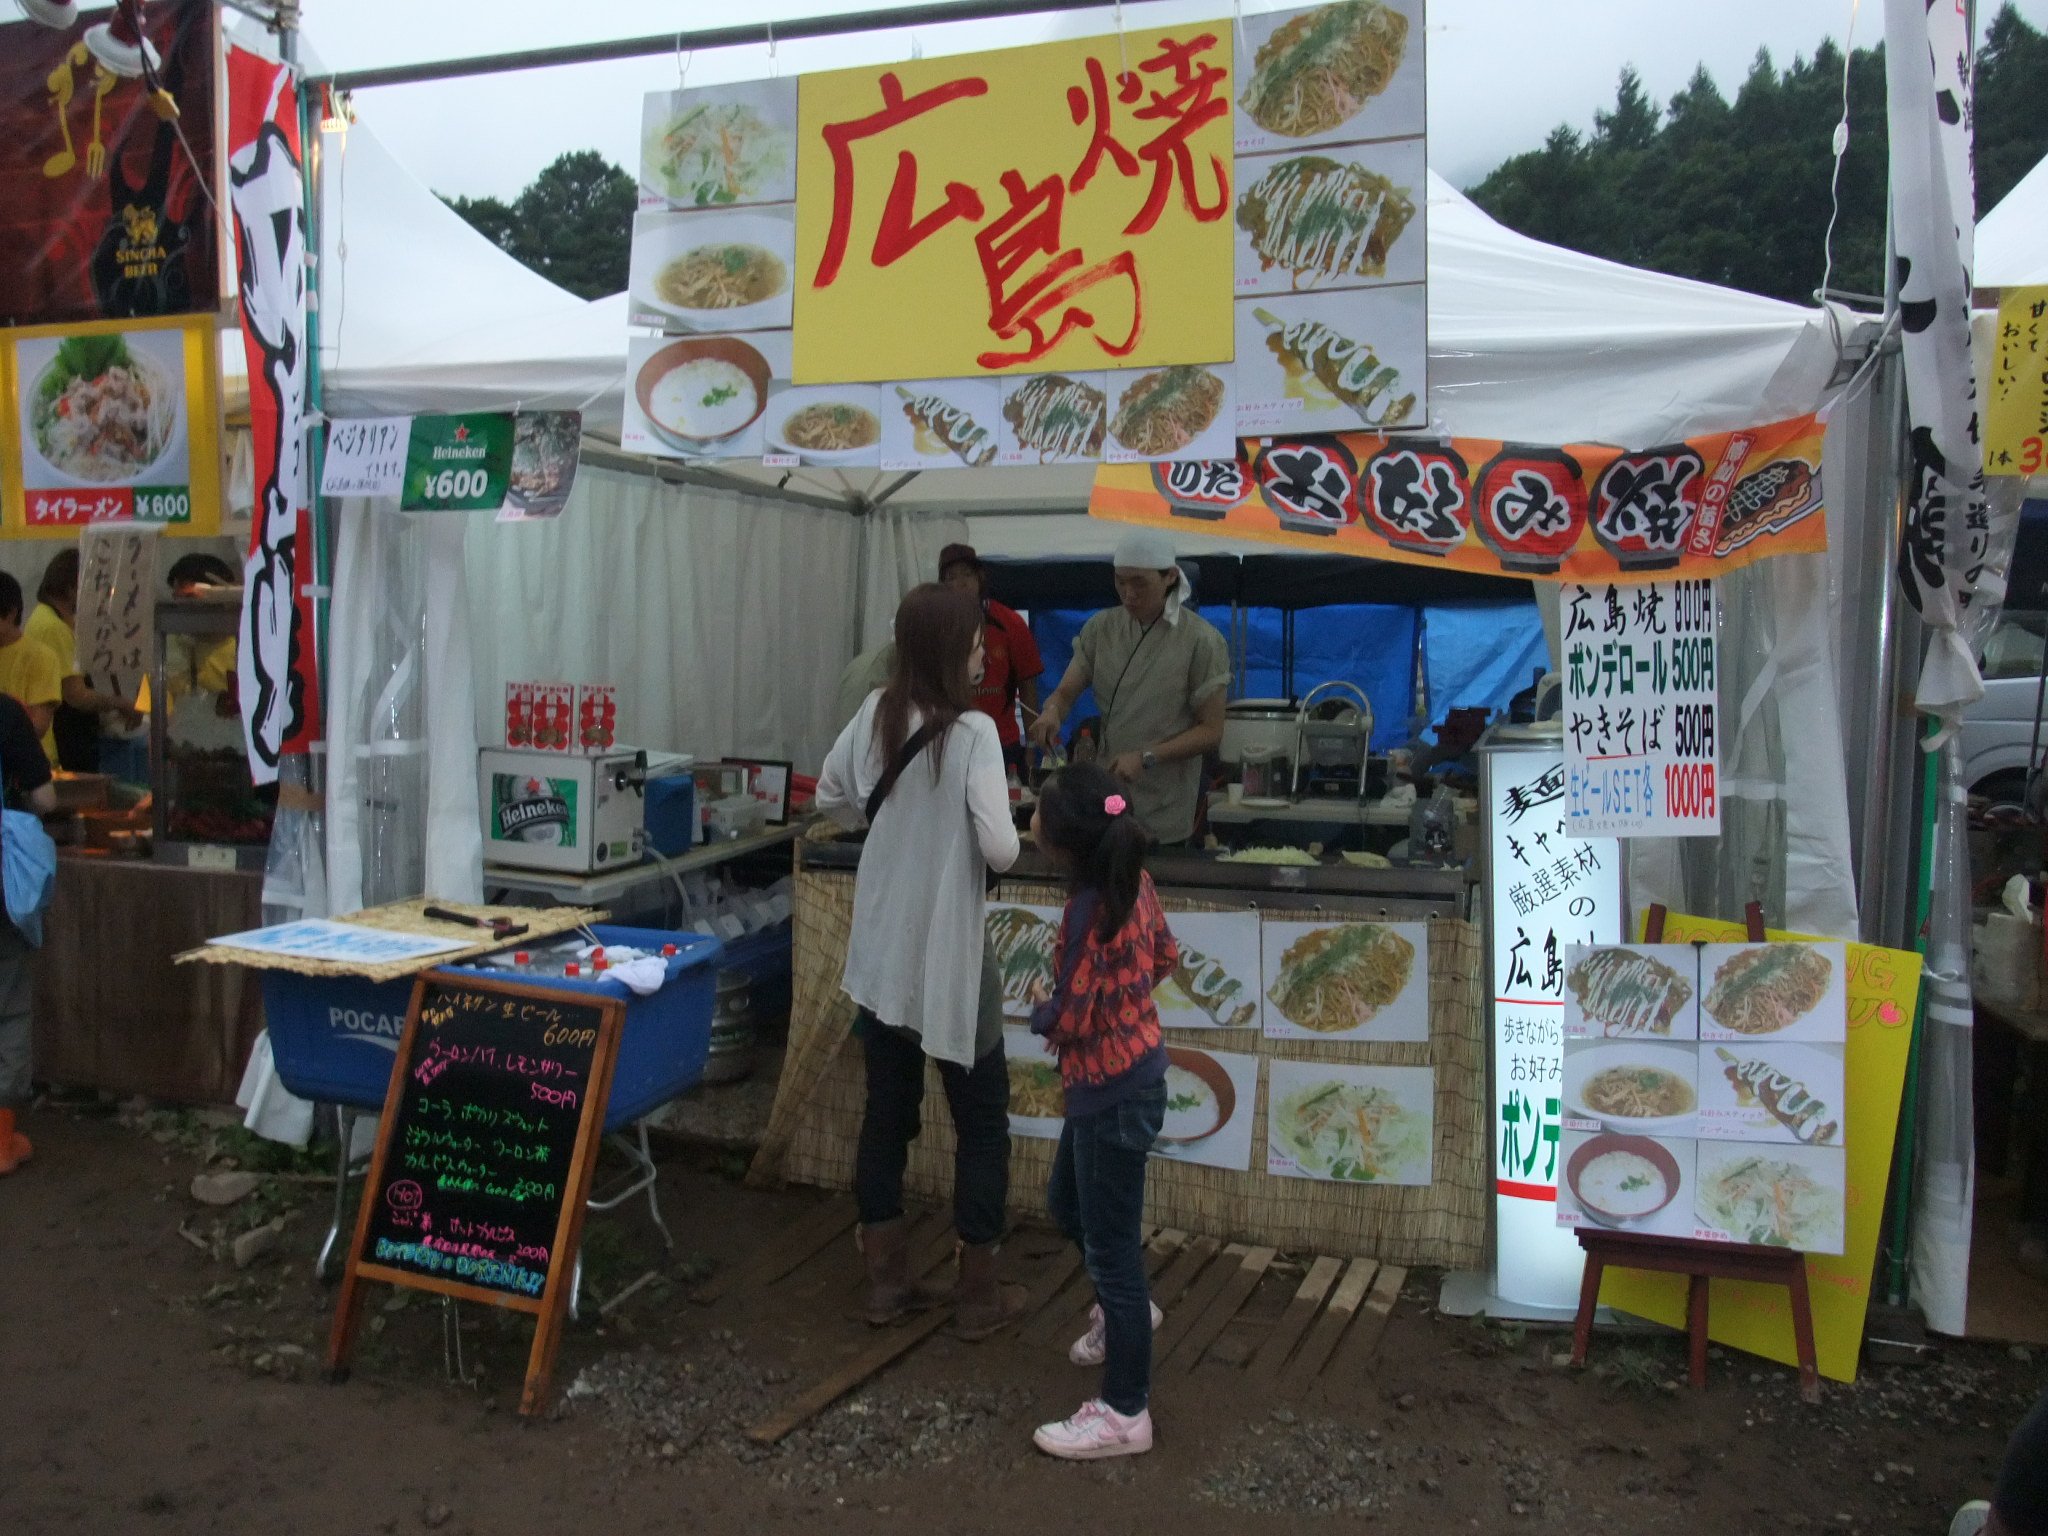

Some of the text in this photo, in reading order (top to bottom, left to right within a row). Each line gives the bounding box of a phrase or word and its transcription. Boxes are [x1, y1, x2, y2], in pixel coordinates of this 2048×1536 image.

[810, 32, 1231, 369] 広島焼
[2029, 300, 2047, 352] 甘くて
[333, 424, 400, 457] ベジタリアン
[432, 444, 487, 461] Heineken
[136, 494, 189, 518] ¥600
[424, 469, 488, 500] ¥600
[1262, 444, 1702, 551] お好み焼
[34, 496, 123, 520] タイラーメン
[1564, 578, 1711, 640] 広島焼 800円
[1568, 636, 1714, 699] ポンデロール 500円
[1569, 703, 1714, 758] やきそば 500円
[1570, 761, 1715, 819] 生ビールSET各 1000円
[502, 800, 568, 827] Heineken
[1508, 841, 1602, 918] 厳選素材
[1568, 896, 1596, 917] の
[1504, 926, 1594, 997] 広島
[543, 1023, 596, 1048] 600円
[1504, 1015, 1564, 1051] 歩きながら
[531, 1080, 577, 1109] 500円
[1502, 1088, 1561, 1182] ポンデ
